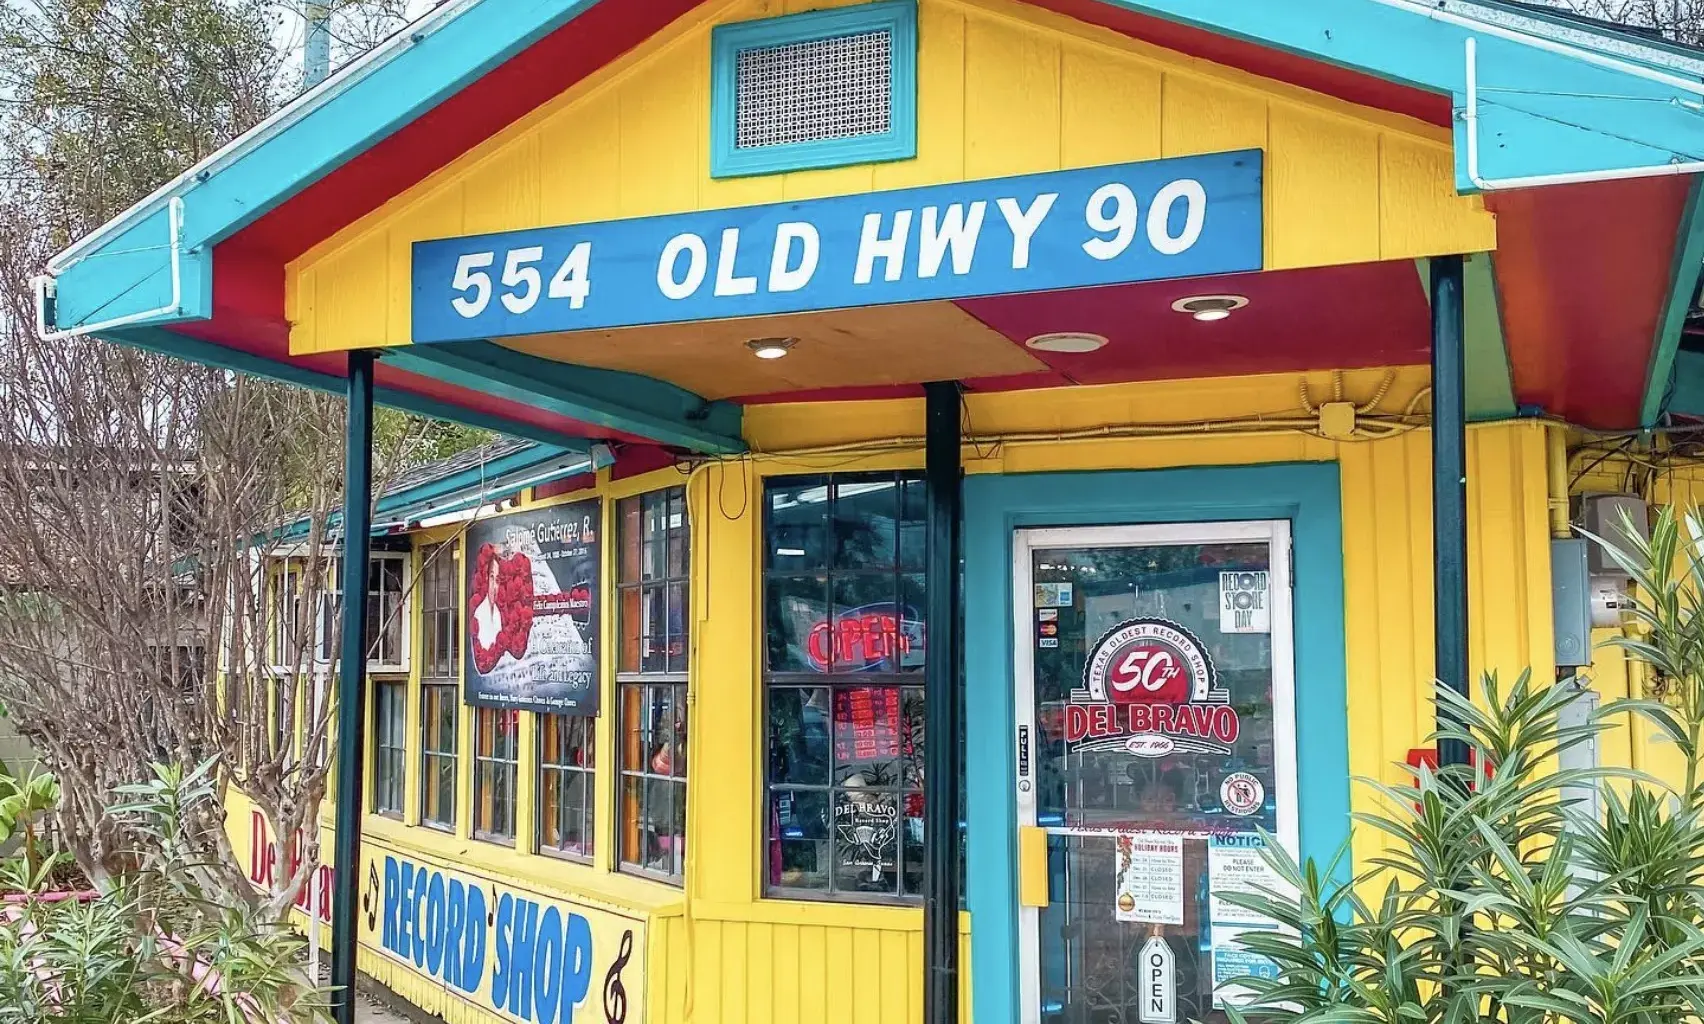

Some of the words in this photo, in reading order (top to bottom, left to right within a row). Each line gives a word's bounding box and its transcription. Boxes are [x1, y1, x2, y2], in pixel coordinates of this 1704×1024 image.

[451, 241, 592, 319] 554
[656, 221, 820, 300] OLD
[853, 192, 1059, 284] HWY
[1082, 178, 1208, 261] 90
[505, 523, 535, 547] Salomé
[583, 515, 595, 537] R.
[1222, 572, 1267, 591] RECORD
[1225, 591, 1264, 610] STORE
[1235, 610, 1252, 629] DAY
[583, 637, 592, 654] of
[808, 616, 910, 666] OPEN
[1041, 639, 1057, 647] VISA
[1093, 650, 1110, 682] TEXAS
[1109, 626, 1148, 648] OLDEST
[1153, 626, 1192, 652] RECORD
[1191, 653, 1206, 684] SHOP
[1065, 702, 1124, 743] DEL
[1129, 702, 1240, 744] BRAVO
[1128, 741, 1148, 749] EST.
[1149, 741, 1169, 749] 1966
[1224, 776, 1234, 785] NO
[1235, 773, 1259, 786] PUBLIC
[835, 804, 858, 817] DEL
[859, 803, 896, 817] BRAVO
[1224, 799, 1261, 814] RESTROOMS
[251, 810, 277, 889] De
[383, 855, 487, 993] RECORD
[491, 891, 593, 1024] SHOP
[1150, 953, 1164, 1013] OPEN
